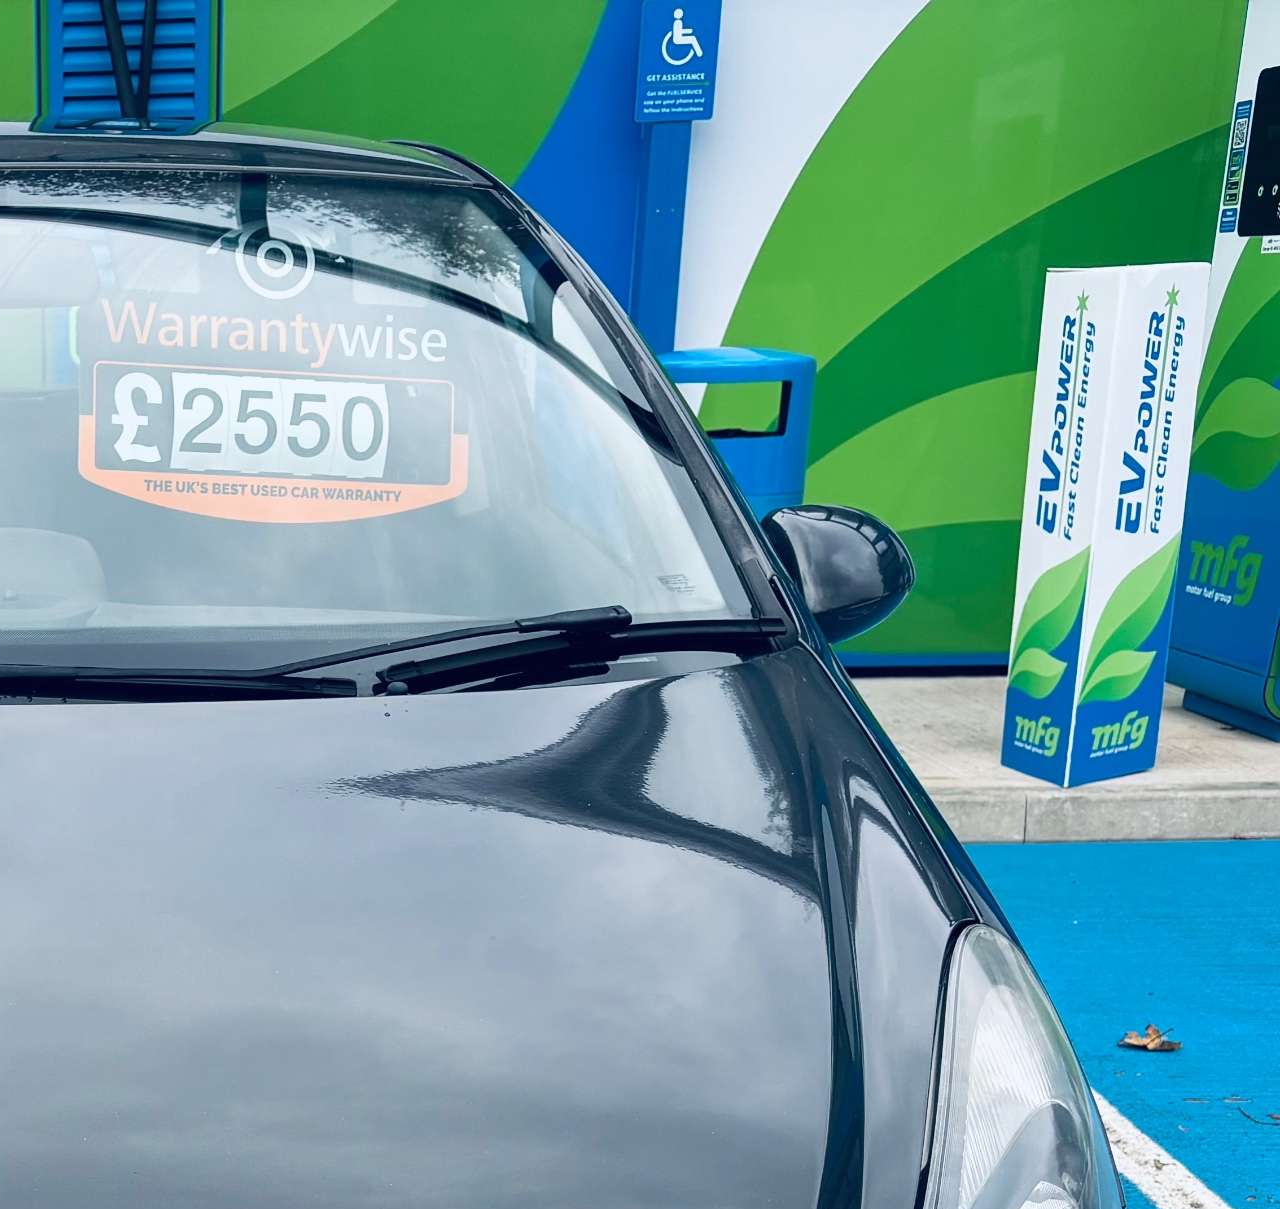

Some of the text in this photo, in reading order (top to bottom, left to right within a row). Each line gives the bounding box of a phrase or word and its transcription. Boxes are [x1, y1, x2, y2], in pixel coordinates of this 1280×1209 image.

[646, 72, 705, 82] GET ASSISTANCE
[101, 298, 448, 369] Warrantywise
[1064, 321, 1096, 541] Fast Clean Energy
[1150, 315, 1186, 535] Fast Clean Energy
[144, 479, 402, 503] THE UK'S BEST USED CAR WARRANTY
